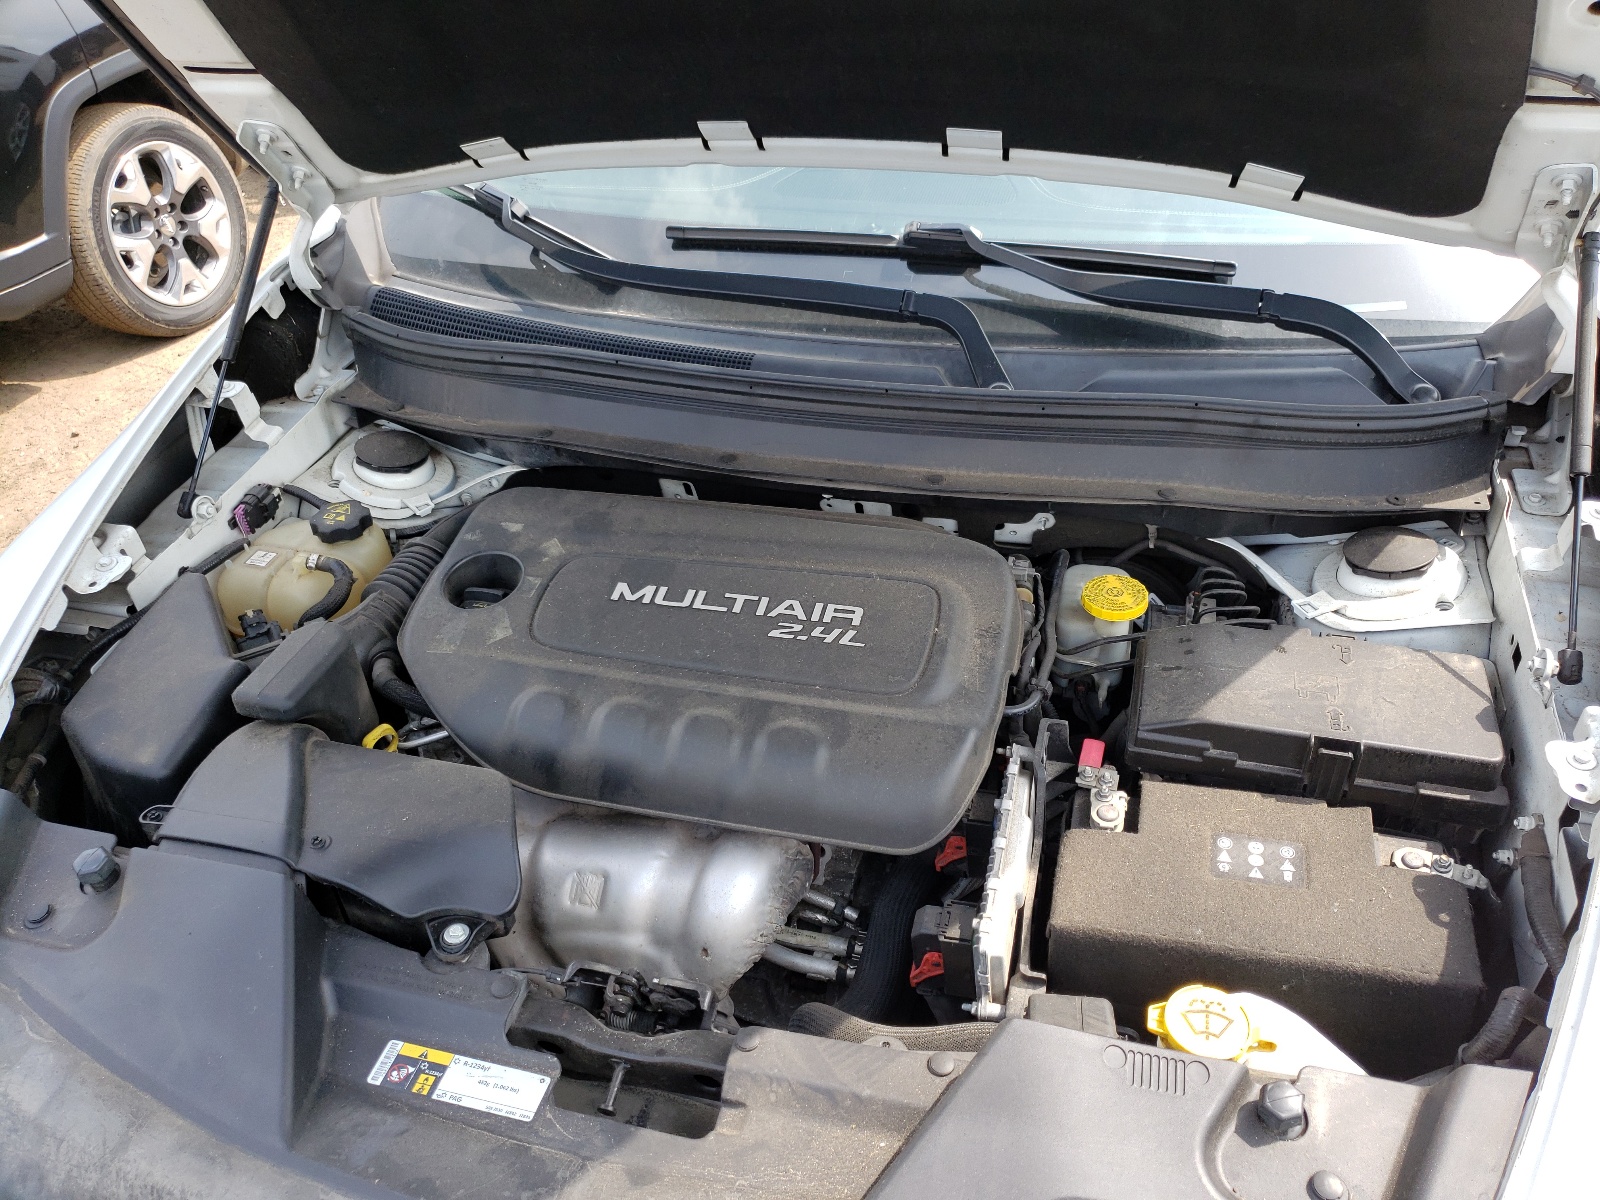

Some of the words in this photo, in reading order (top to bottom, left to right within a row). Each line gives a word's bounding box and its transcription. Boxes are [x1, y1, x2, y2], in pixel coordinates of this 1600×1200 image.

[610, 582, 864, 625] MULTIAIR
[766, 622, 866, 647] 2.4L
[463, 1060, 491, 1072] R-1234yf
[448, 1094, 462, 1103] PAG
